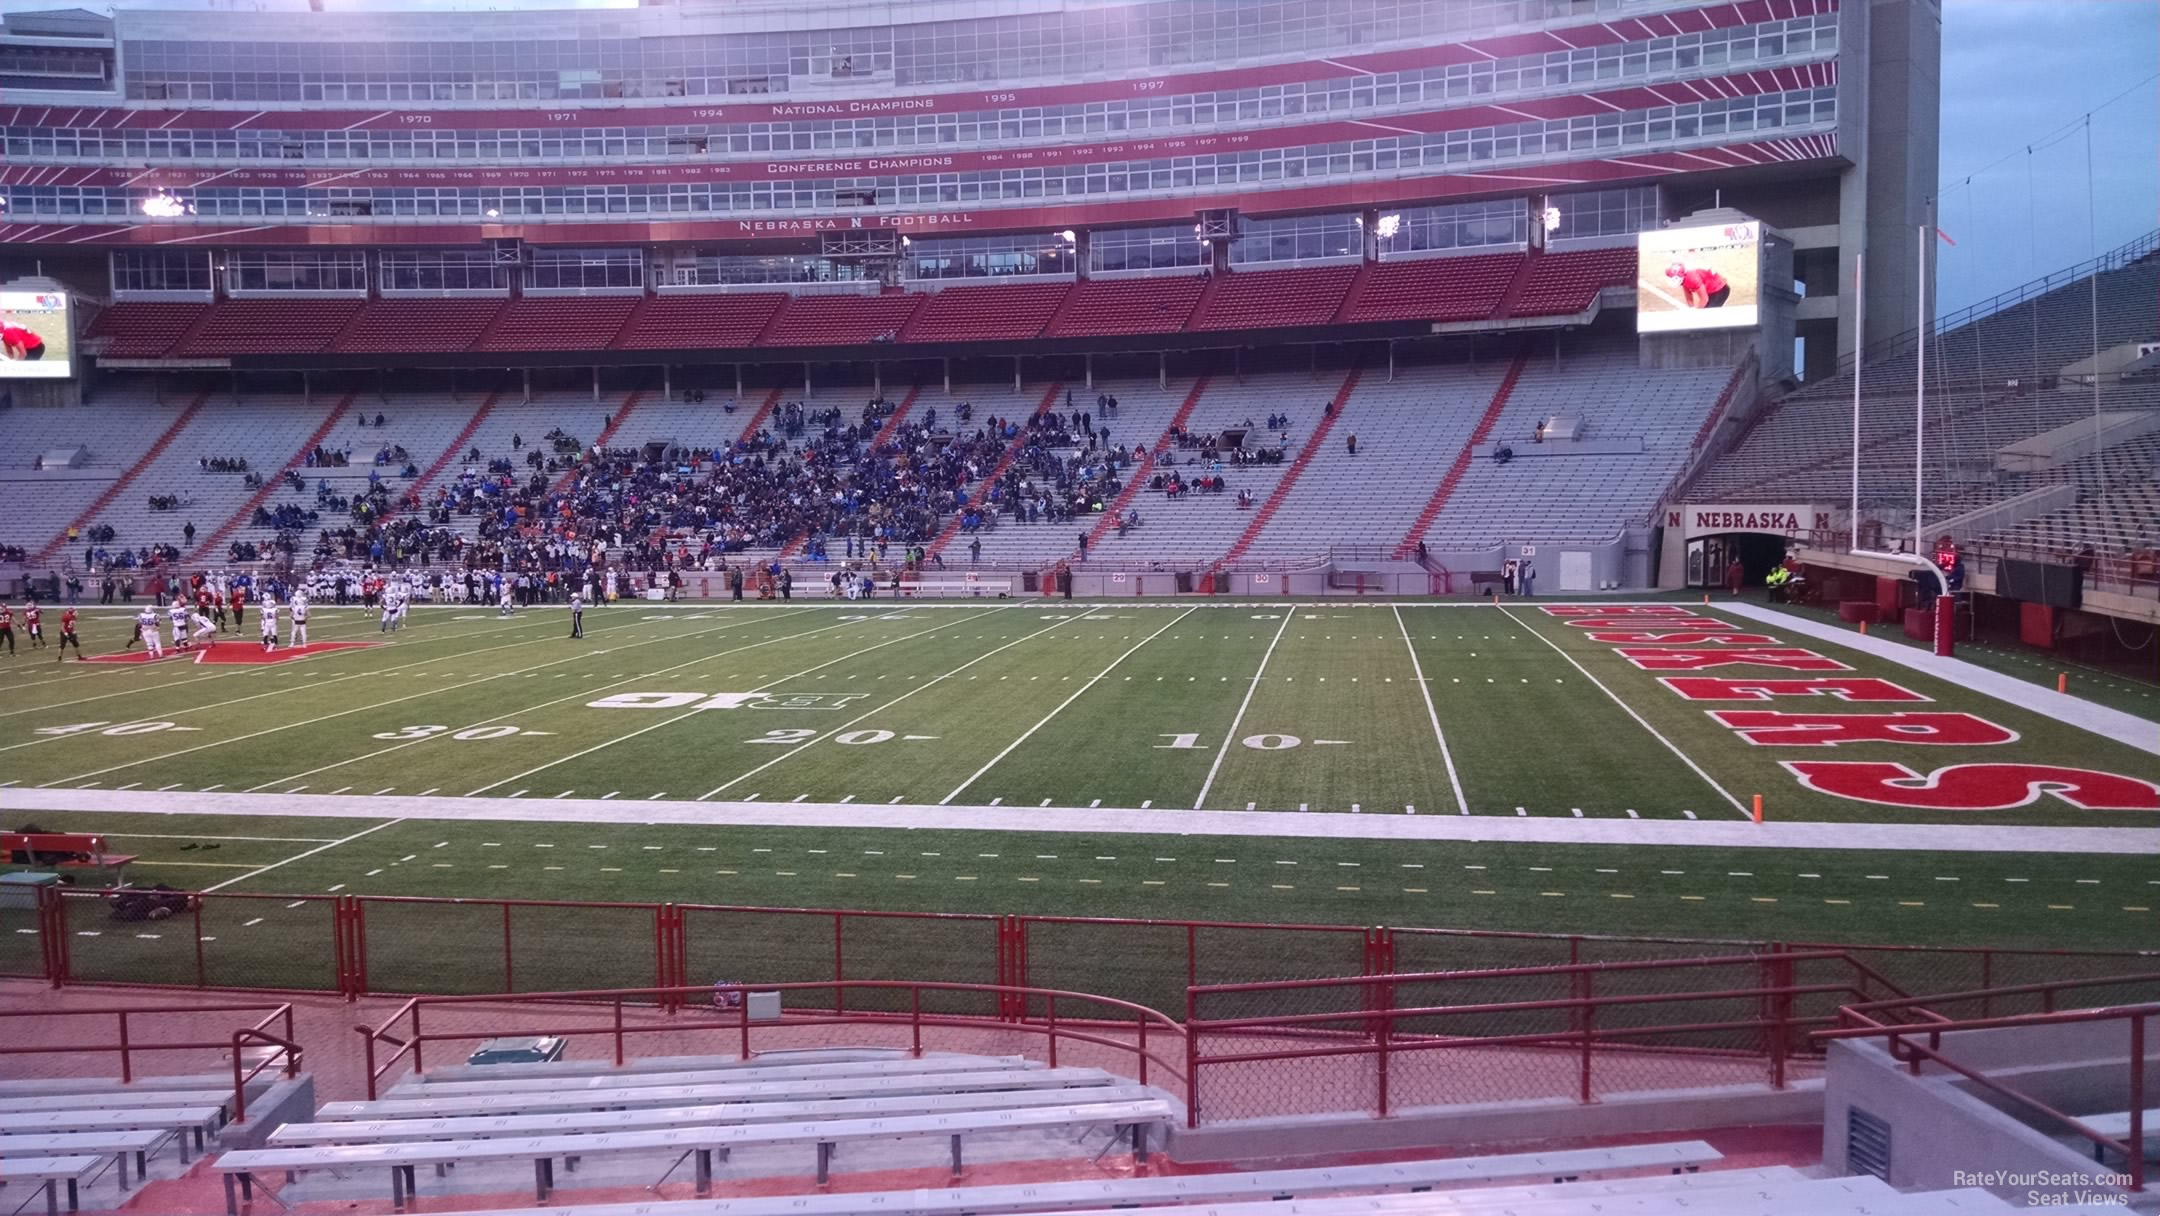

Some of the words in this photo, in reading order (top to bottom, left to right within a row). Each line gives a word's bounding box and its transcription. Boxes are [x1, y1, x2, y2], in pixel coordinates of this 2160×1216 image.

[399, 114, 432, 124] 1970
[547, 113, 577, 122] 1971
[692, 109, 724, 118] 1994
[772, 104, 843, 116] NATIONAL
[849, 99, 934, 112] CHAMPIONS
[984, 93, 1016, 103] 1995
[1132, 81, 1165, 92] 1997
[767, 161, 862, 173] CONFERENCE
[868, 156, 952, 170] CHAMPIONS
[740, 220, 836, 231] NEBRASKA
[851, 217, 862, 228] N
[880, 214, 972, 226] FOOTBALL
[1668, 512, 1681, 527] N
[1696, 512, 1799, 529] NEBRASKA
[1815, 513, 1829, 530] N
[174, 612, 185, 620] 56
[1538, 605, 2160, 812] HUSKERS
[33, 721, 176, 736] 40
[373, 724, 521, 740] 30
[743, 729, 896, 744] 20
[1153, 733, 1301, 749] 10
